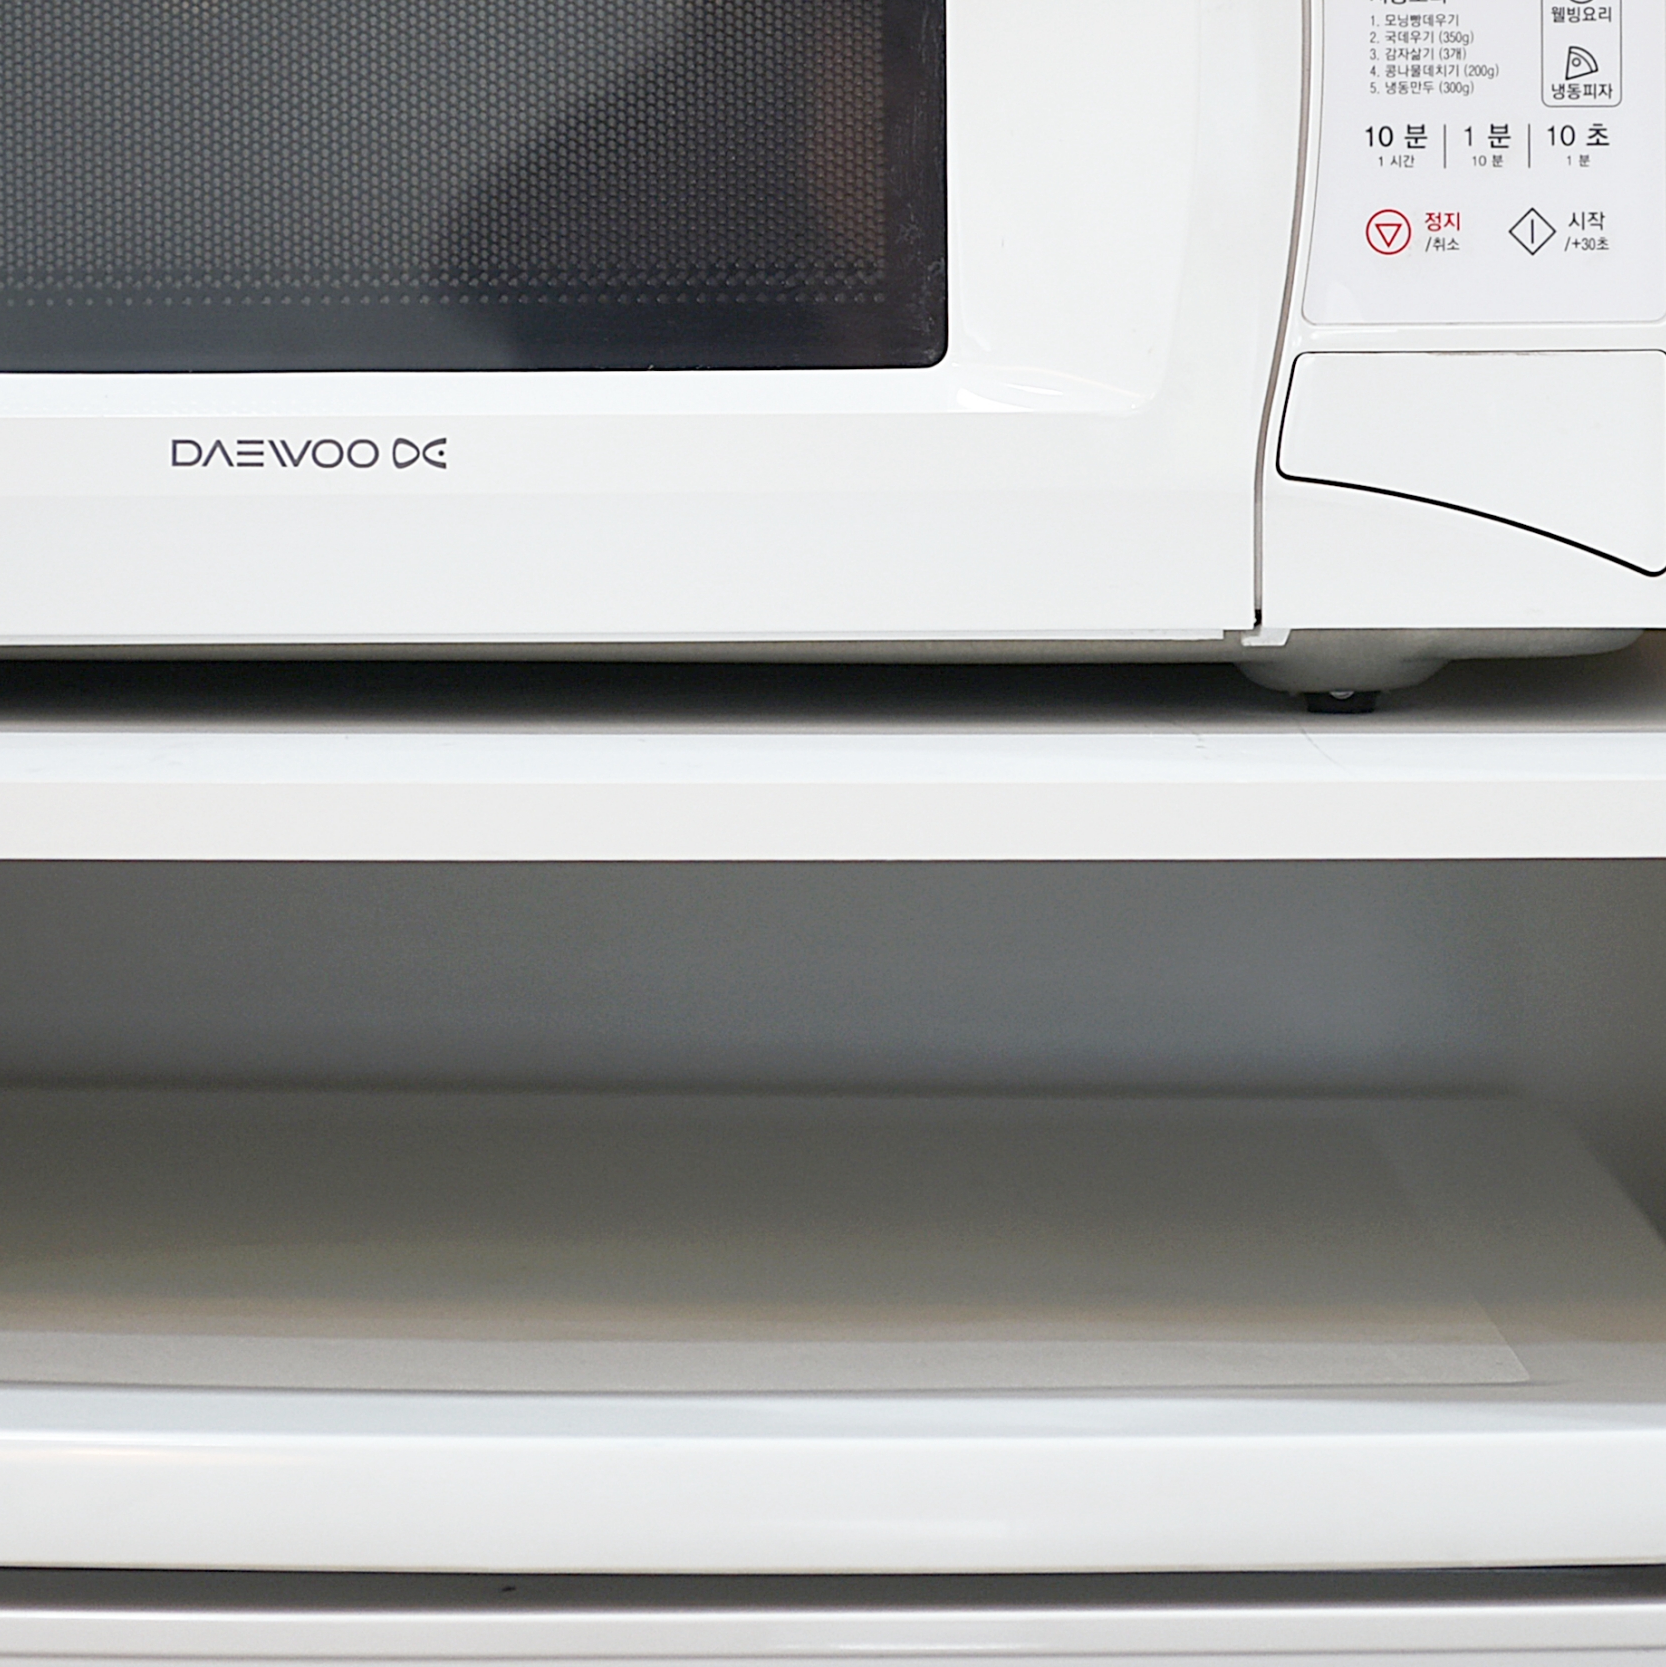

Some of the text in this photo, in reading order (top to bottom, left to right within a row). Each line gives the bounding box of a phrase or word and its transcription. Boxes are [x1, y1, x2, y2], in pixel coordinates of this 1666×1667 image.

[1370, 13, 1459, 28] 1. 모닝빵데우기
[1551, 6, 1612, 24] 웰빙요리
[1369, 30, 1474, 47] 2. 국데우기 (350g)
[1369, 47, 1467, 62] 3. 감자삶기 (3개)
[1369, 64, 1500, 80] 4. 콩나물데치기 (200g)
[1369, 81, 1475, 97] 5. 냉동만두 (300g)
[1551, 83, 1613, 100] 냉동피자
[1365, 124, 1428, 149] 10 분
[1464, 123, 1511, 149] 1 분
[1547, 123, 1610, 147] 10 초
[1378, 154, 1415, 168] 1 시간
[1472, 154, 1503, 168] 10 분
[1566, 154, 1590, 168] 1 분
[1424, 211, 1460, 232] 정지
[1568, 211, 1605, 231] 시작
[1425, 236, 1459, 252] /취소
[1564, 236, 1609, 252] /+30초
[171, 438, 380, 469] DAEWOO
